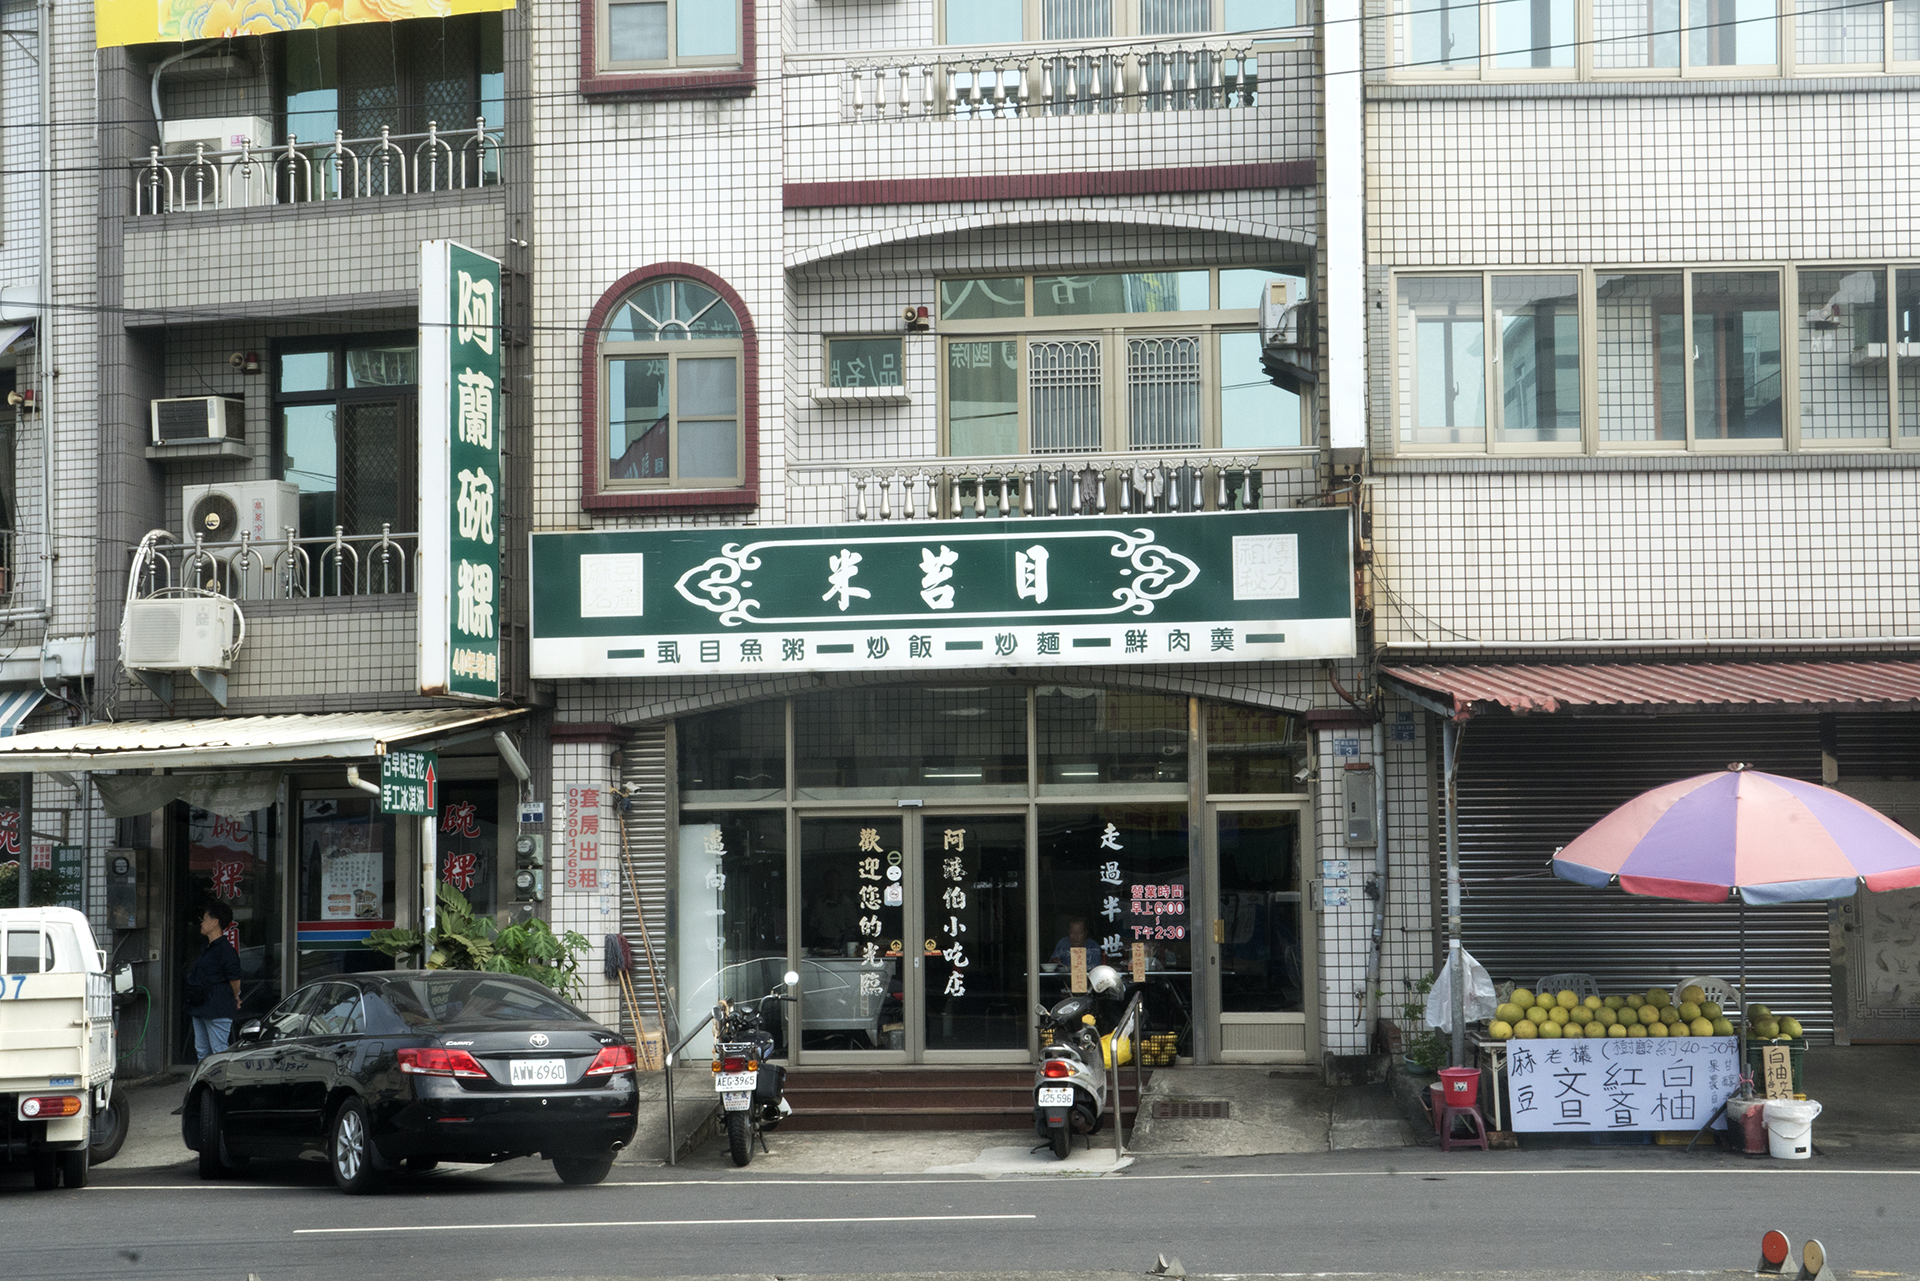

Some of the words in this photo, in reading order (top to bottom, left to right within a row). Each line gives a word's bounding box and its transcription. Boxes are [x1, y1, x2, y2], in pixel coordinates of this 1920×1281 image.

[457, 270, 494, 638] 阿蘭碗粿
[822, 544, 1050, 612] 米苔目
[657, 637, 805, 664] 虱目魚粥
[866, 634, 932, 660] 炒飯
[995, 631, 1061, 656] 炒麵
[1124, 627, 1235, 654] 鮮肉羹
[453, 648, 497, 683] 40年老店
[383, 752, 425, 780] 古早味豆花
[1345, 747, 1353, 756] 3
[383, 784, 426, 812] 手工冰淇淋
[440, 801, 481, 892] 碗粿
[567, 788, 579, 888] 0929012659
[578, 788, 600, 888] 套房出租
[1100, 822, 1124, 958] 走過半世
[1130, 884, 1185, 899] 營業時間
[1130, 901, 1185, 915] 早上6:00
[858, 828, 884, 996] 歡迎您的光臨
[942, 828, 970, 997] 阿港伯小吃店
[1130, 925, 1186, 940] 下午2:30
[512, 1065, 565, 1081] AWW-6960
[717, 1075, 755, 1087] AEG-3965
[1511, 1047, 1538, 1114] 麻豆
[1651, 1059, 1695, 1122] 白柚
[1040, 1093, 1072, 1104] J25-596
